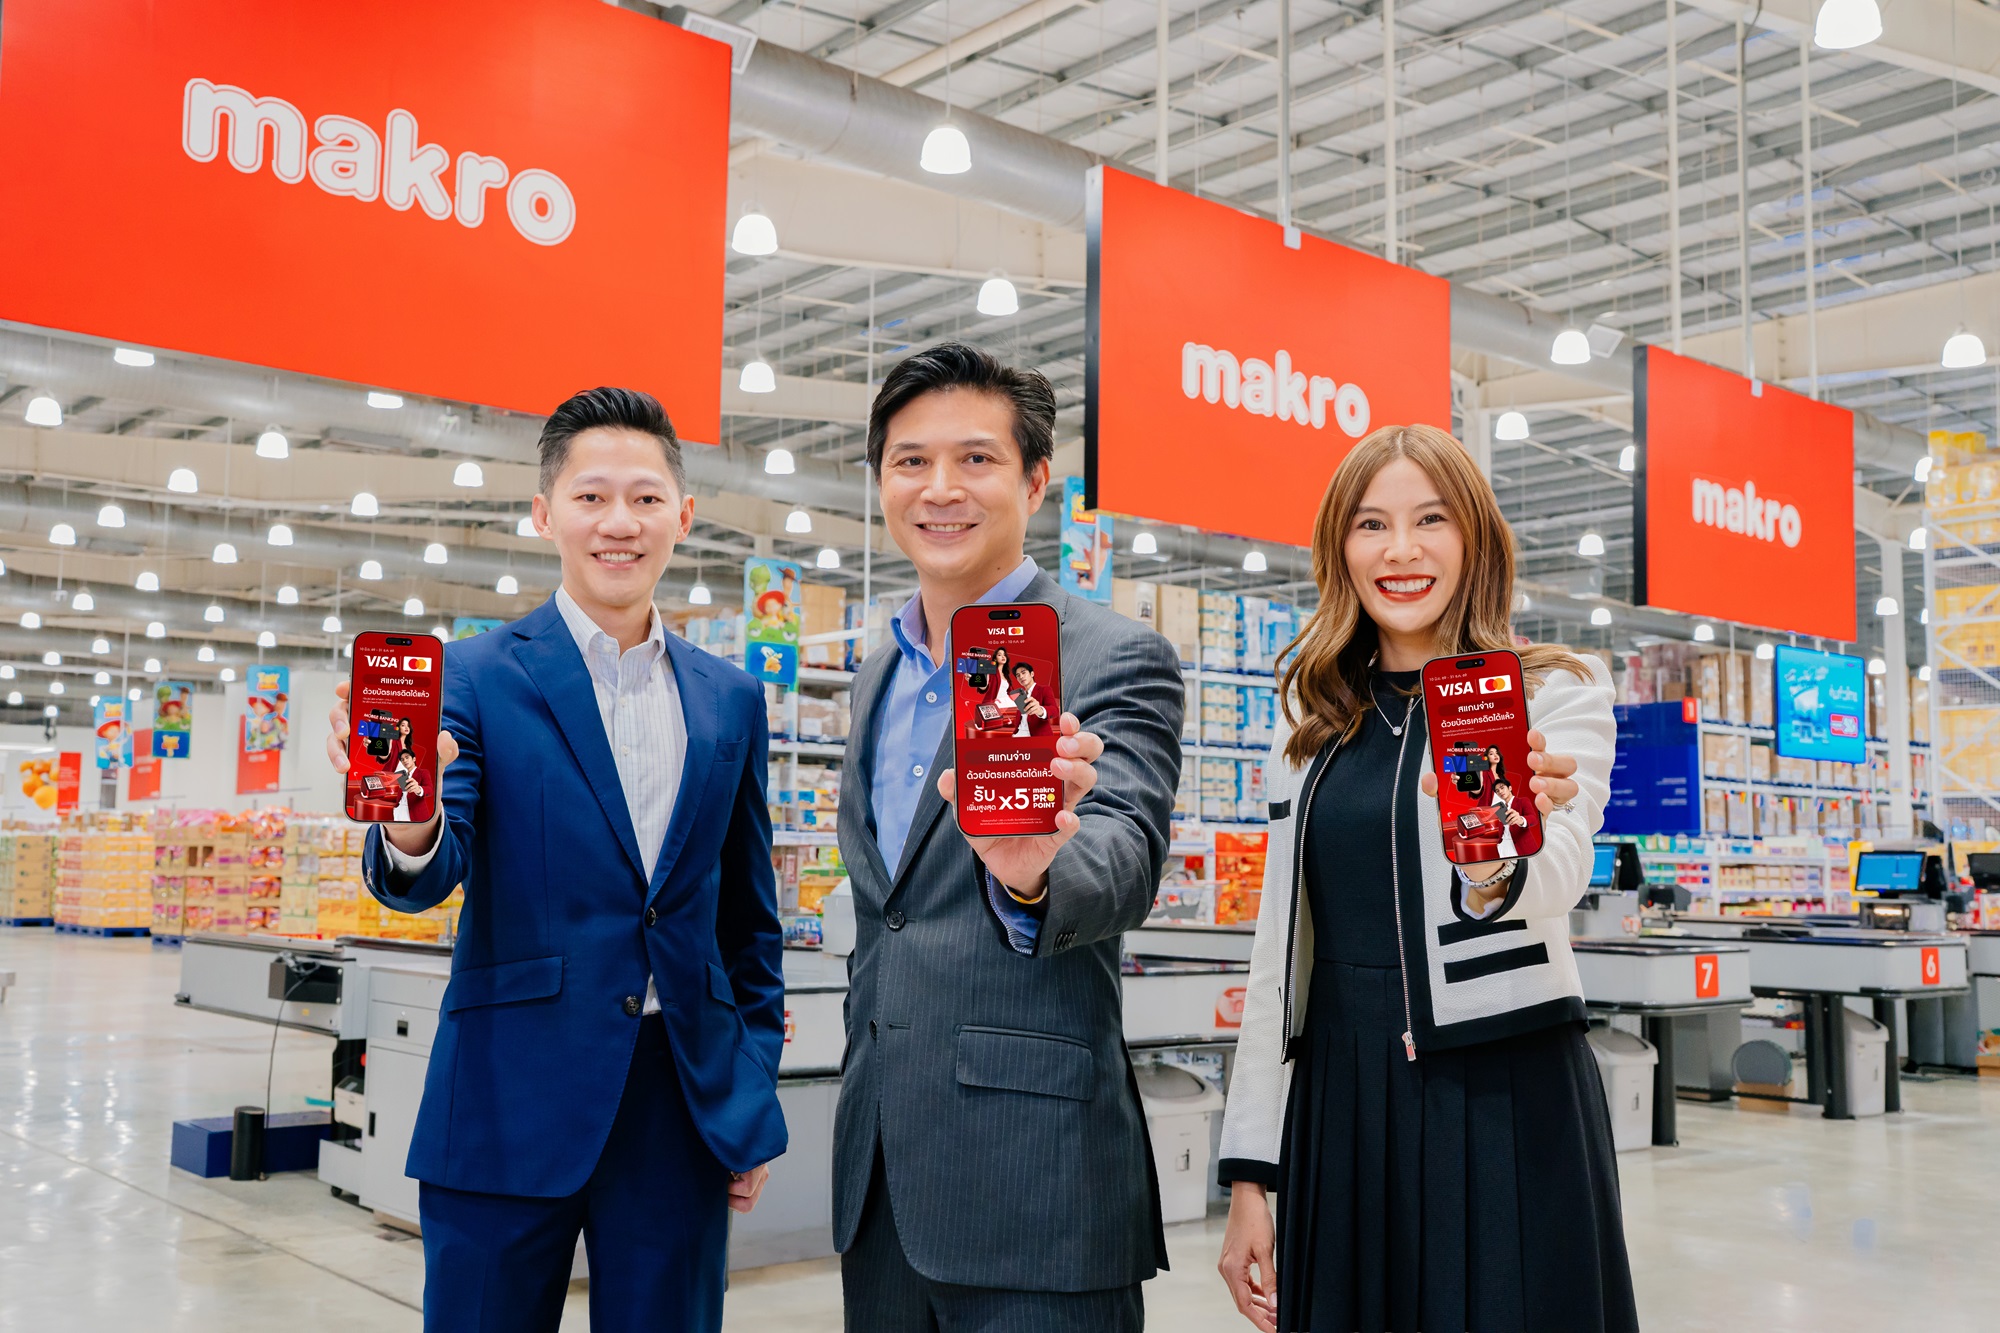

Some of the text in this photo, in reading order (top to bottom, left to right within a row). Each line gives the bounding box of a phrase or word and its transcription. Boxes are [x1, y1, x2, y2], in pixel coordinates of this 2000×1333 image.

[182, 77, 577, 247] makro
[1182, 342, 1370, 438] makro
[1692, 478, 1802, 548] makro
[364, 655, 398, 668] VISA
[380, 677, 414, 686] สแกนจ่าย
[1435, 681, 1474, 697] VISA
[1457, 700, 1495, 713] สแกนจ่าย
[987, 750, 1031, 762] สแกนจ่าย
[974, 784, 996, 803] รับ
[1926, 954, 1936, 978] 6
[1701, 962, 1713, 990] 7
